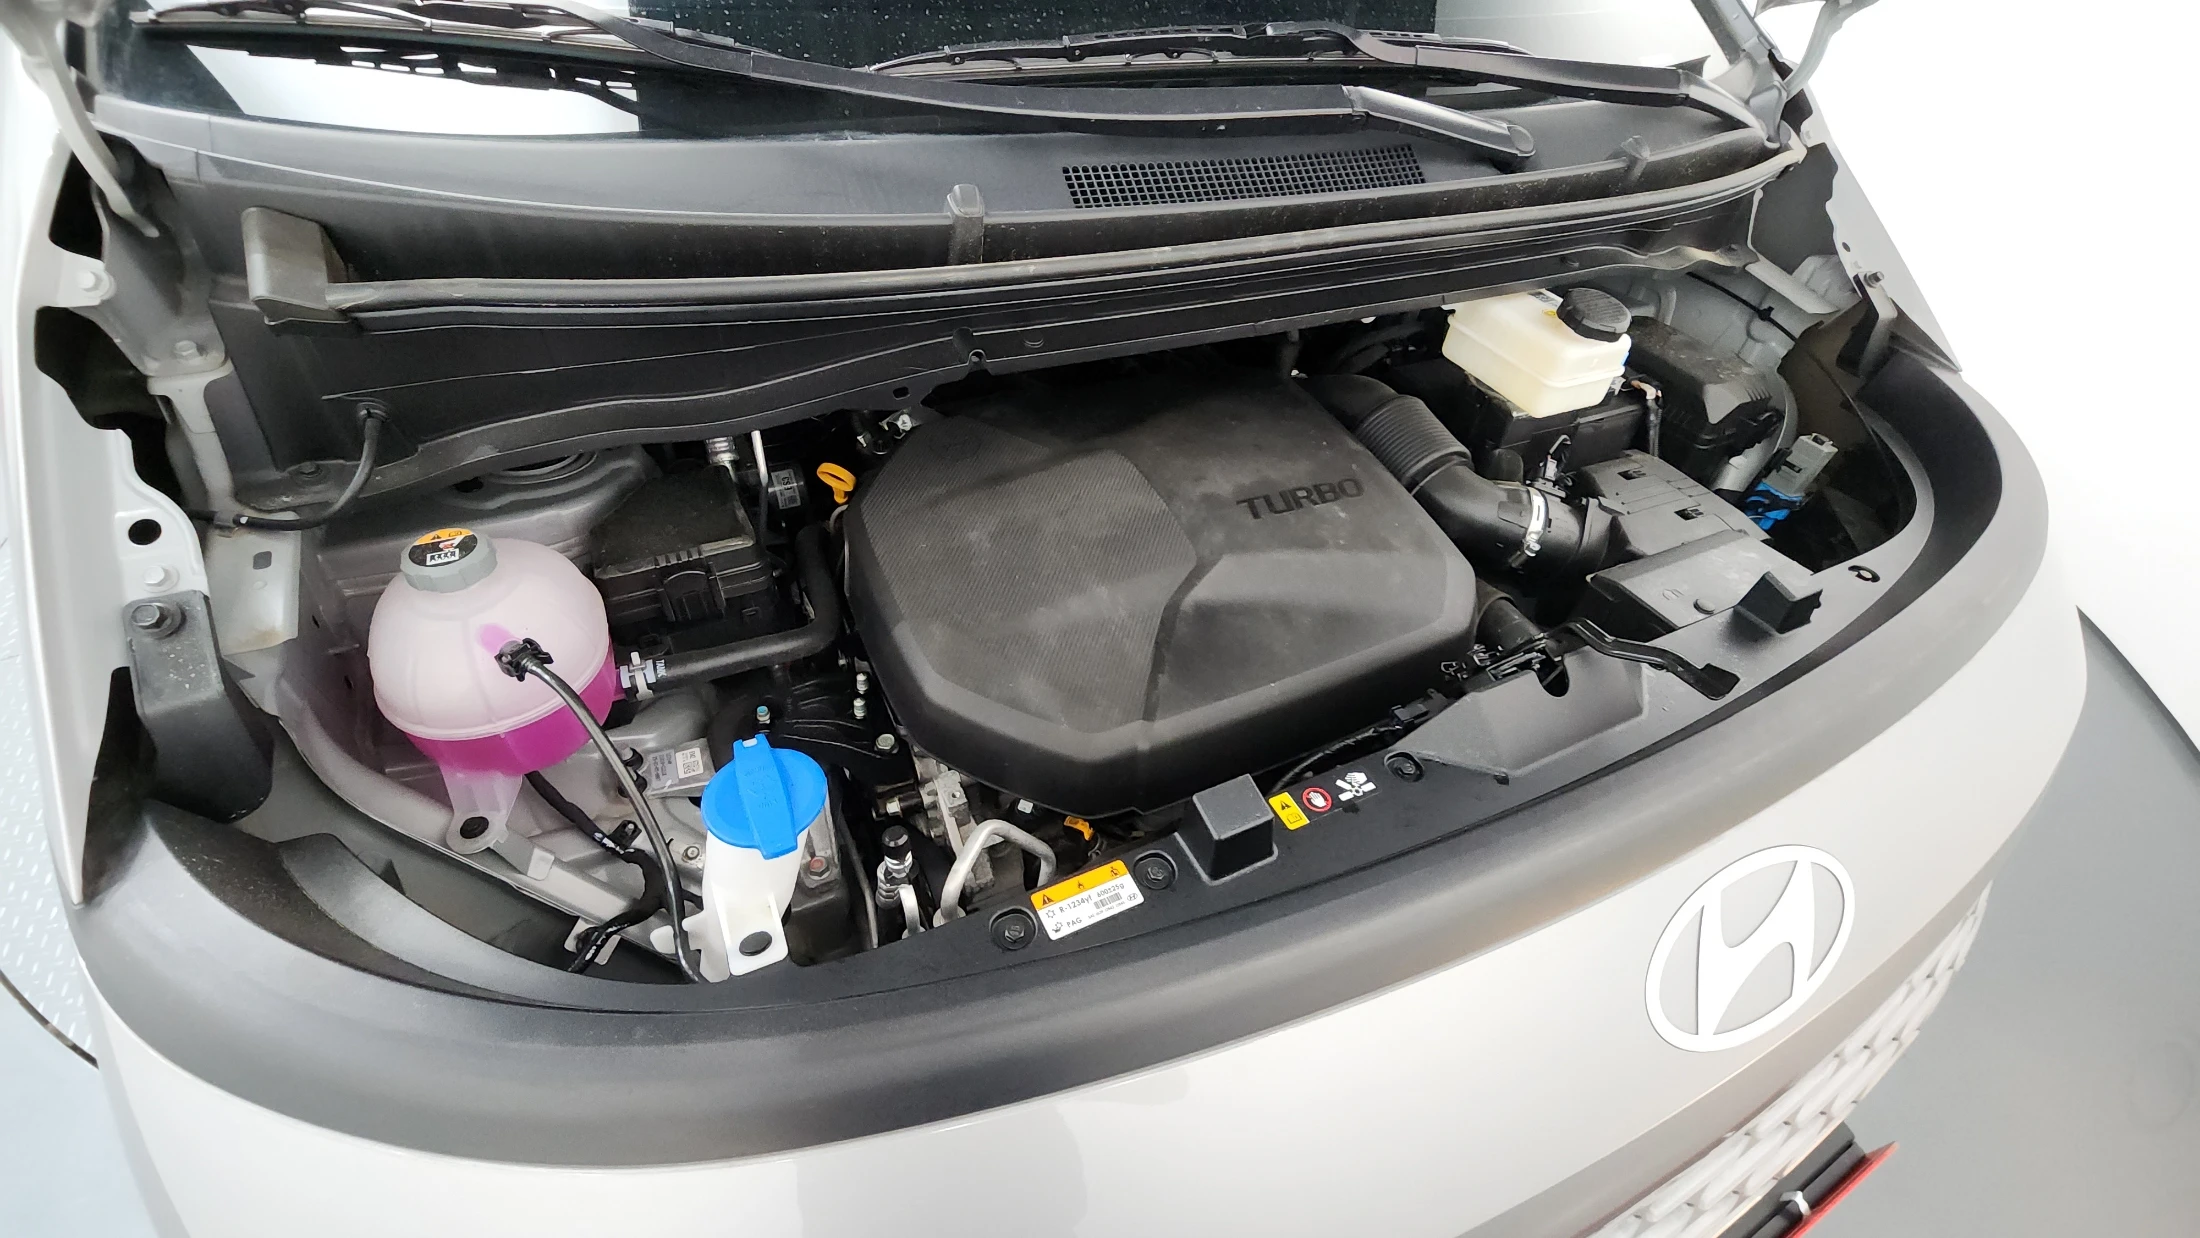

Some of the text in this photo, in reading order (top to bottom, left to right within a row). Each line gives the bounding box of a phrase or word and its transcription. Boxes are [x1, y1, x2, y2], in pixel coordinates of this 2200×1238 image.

[1235, 478, 1366, 520] TURBO
[655, 659, 667, 678] TANK
[1066, 917, 1083, 928] PAG
